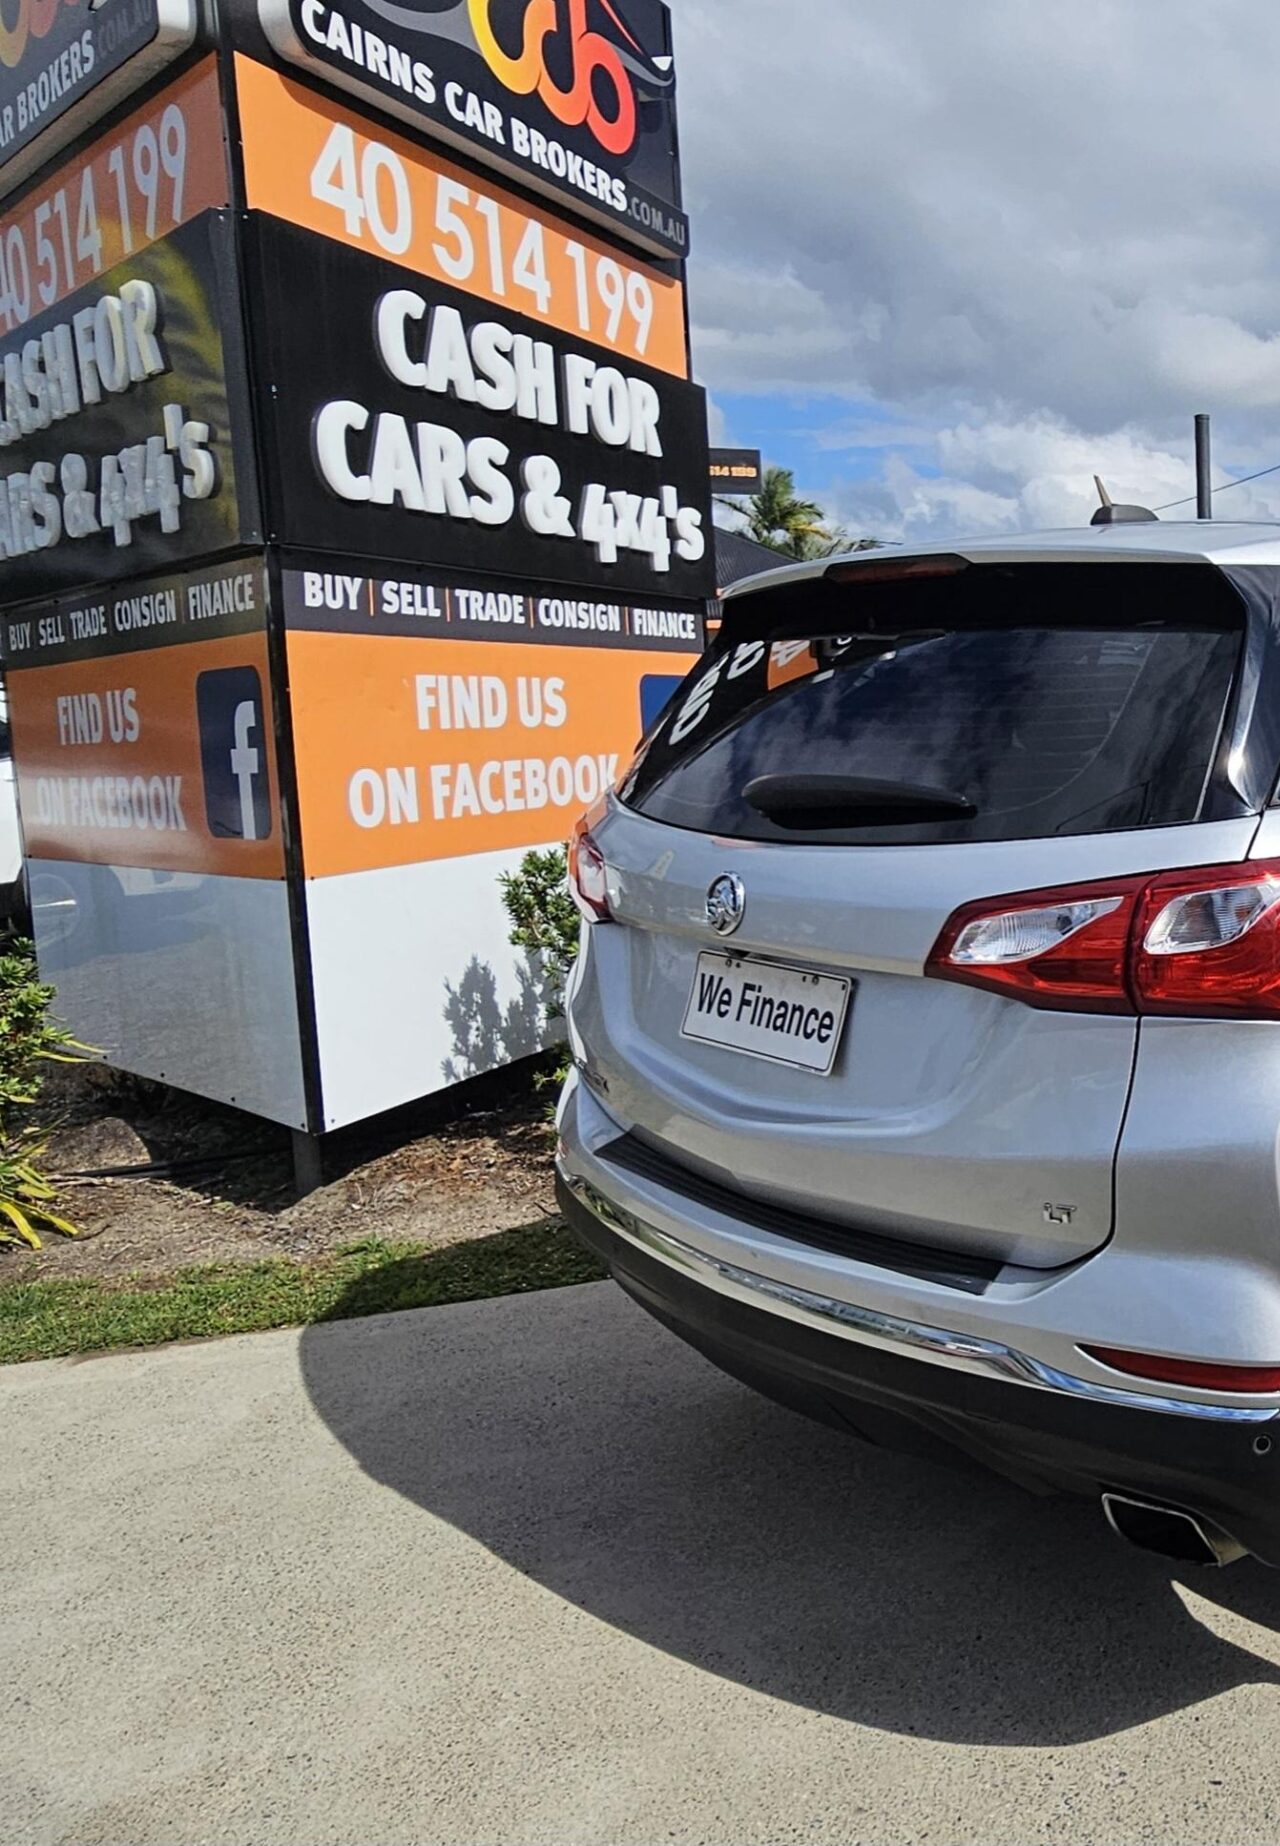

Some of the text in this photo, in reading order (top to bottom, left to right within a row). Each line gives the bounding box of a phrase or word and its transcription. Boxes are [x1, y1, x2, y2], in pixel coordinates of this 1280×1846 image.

[301, 0, 436, 103] CAIRNS
[444, 82, 505, 145] CAR
[34, 165, 102, 305] 514
[109, 104, 186, 254] 199
[310, 122, 653, 355] 40 514 199
[73, 279, 164, 404] FOR
[374, 289, 662, 458] CASH FOR
[61, 453, 101, 538] &
[312, 400, 514, 525] CARS
[520, 454, 576, 537] &
[9, 574, 255, 651] BUY SELL TRADE CONSIGN FINANCE
[304, 572, 696, 640] BUY SELL TRADE CONSIGN FINANCE
[57, 687, 140, 745] FIND US
[415, 674, 567, 730] FIND US
[36, 775, 187, 832] ON FACEBOOK
[348, 753, 619, 829] ON FACEBOOK
[697, 972, 835, 1043] We Finance
